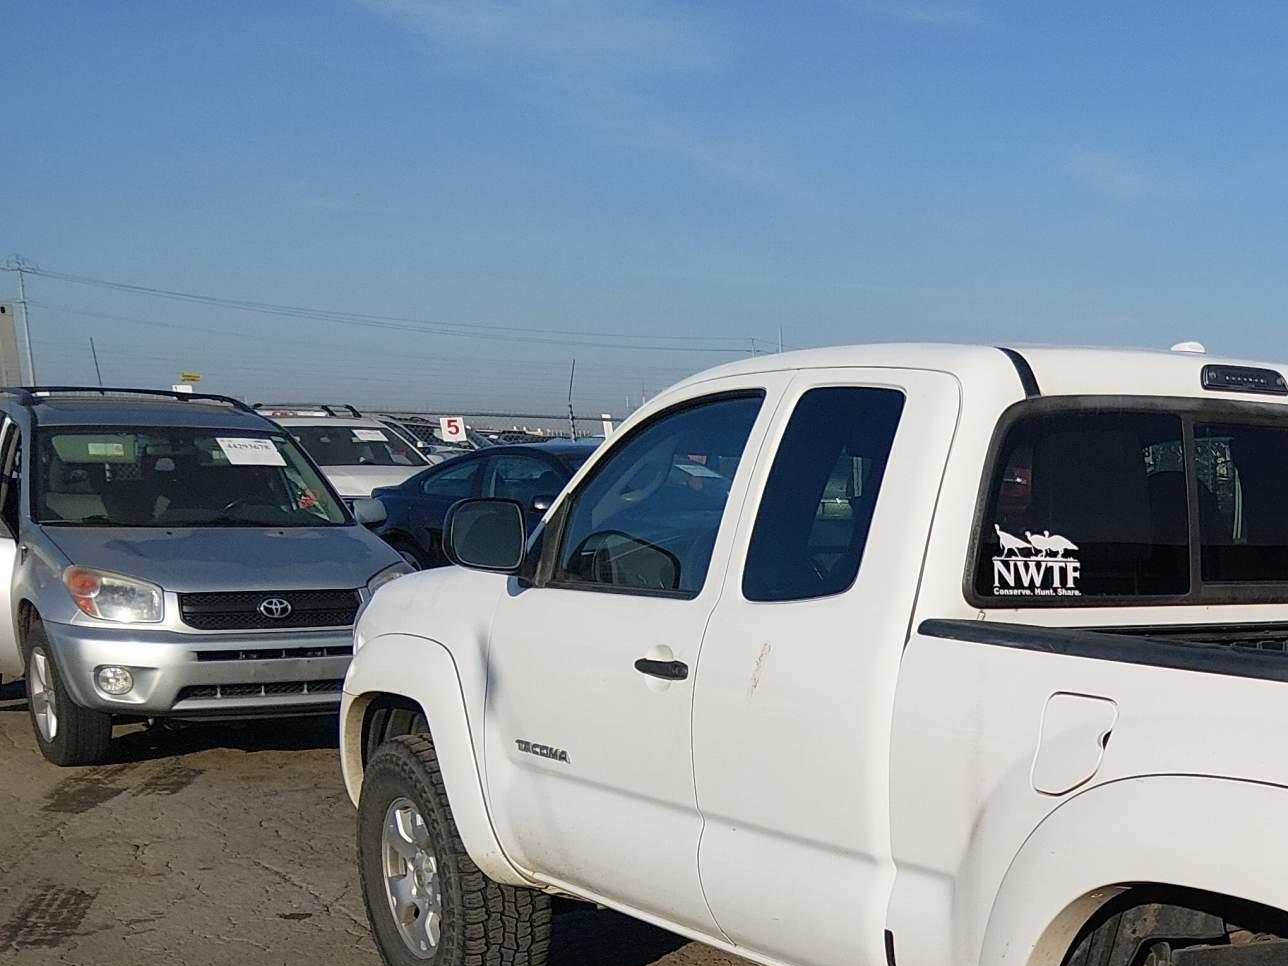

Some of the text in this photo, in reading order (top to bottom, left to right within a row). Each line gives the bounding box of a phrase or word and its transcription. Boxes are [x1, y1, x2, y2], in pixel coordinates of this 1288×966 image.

[447, 419, 460, 435] 5
[992, 561, 1081, 588] NWTF
[993, 588, 1082, 596] Conserve. Hunt. Share.
[515, 739, 571, 764] TACOMA
